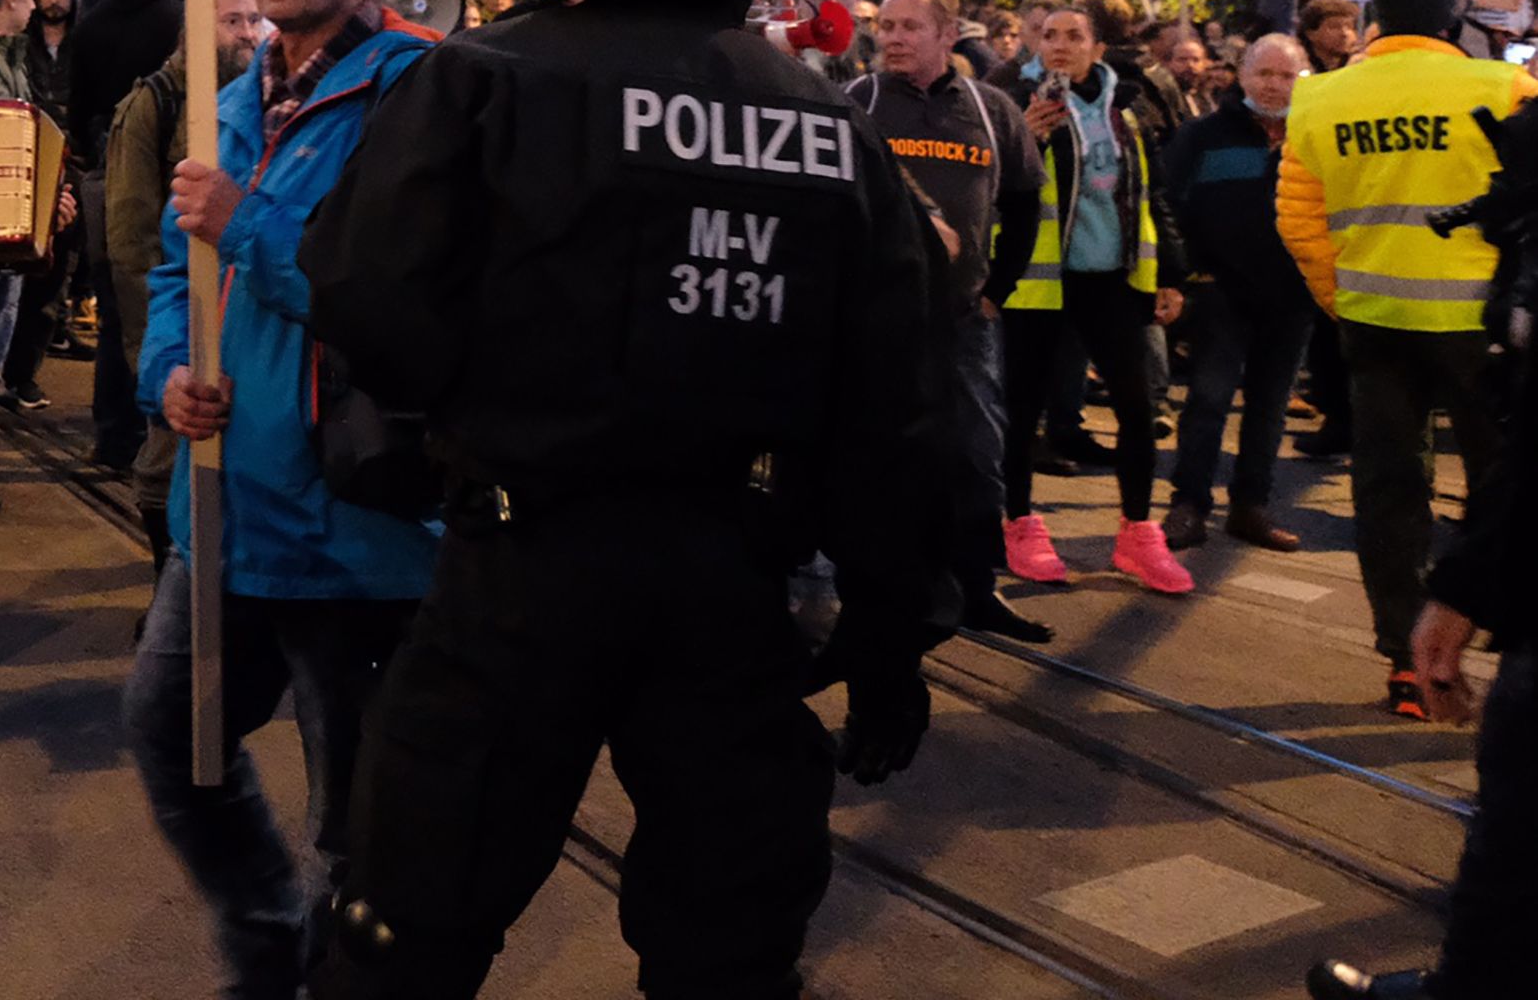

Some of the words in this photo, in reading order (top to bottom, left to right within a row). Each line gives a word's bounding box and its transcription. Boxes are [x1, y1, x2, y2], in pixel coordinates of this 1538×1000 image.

[622, 86, 856, 182] POLIZEI
[886, 138, 966, 162] OODSTOCK
[1335, 115, 1450, 157] PRESSE
[688, 205, 781, 265] M-V
[667, 263, 786, 325] 3131
